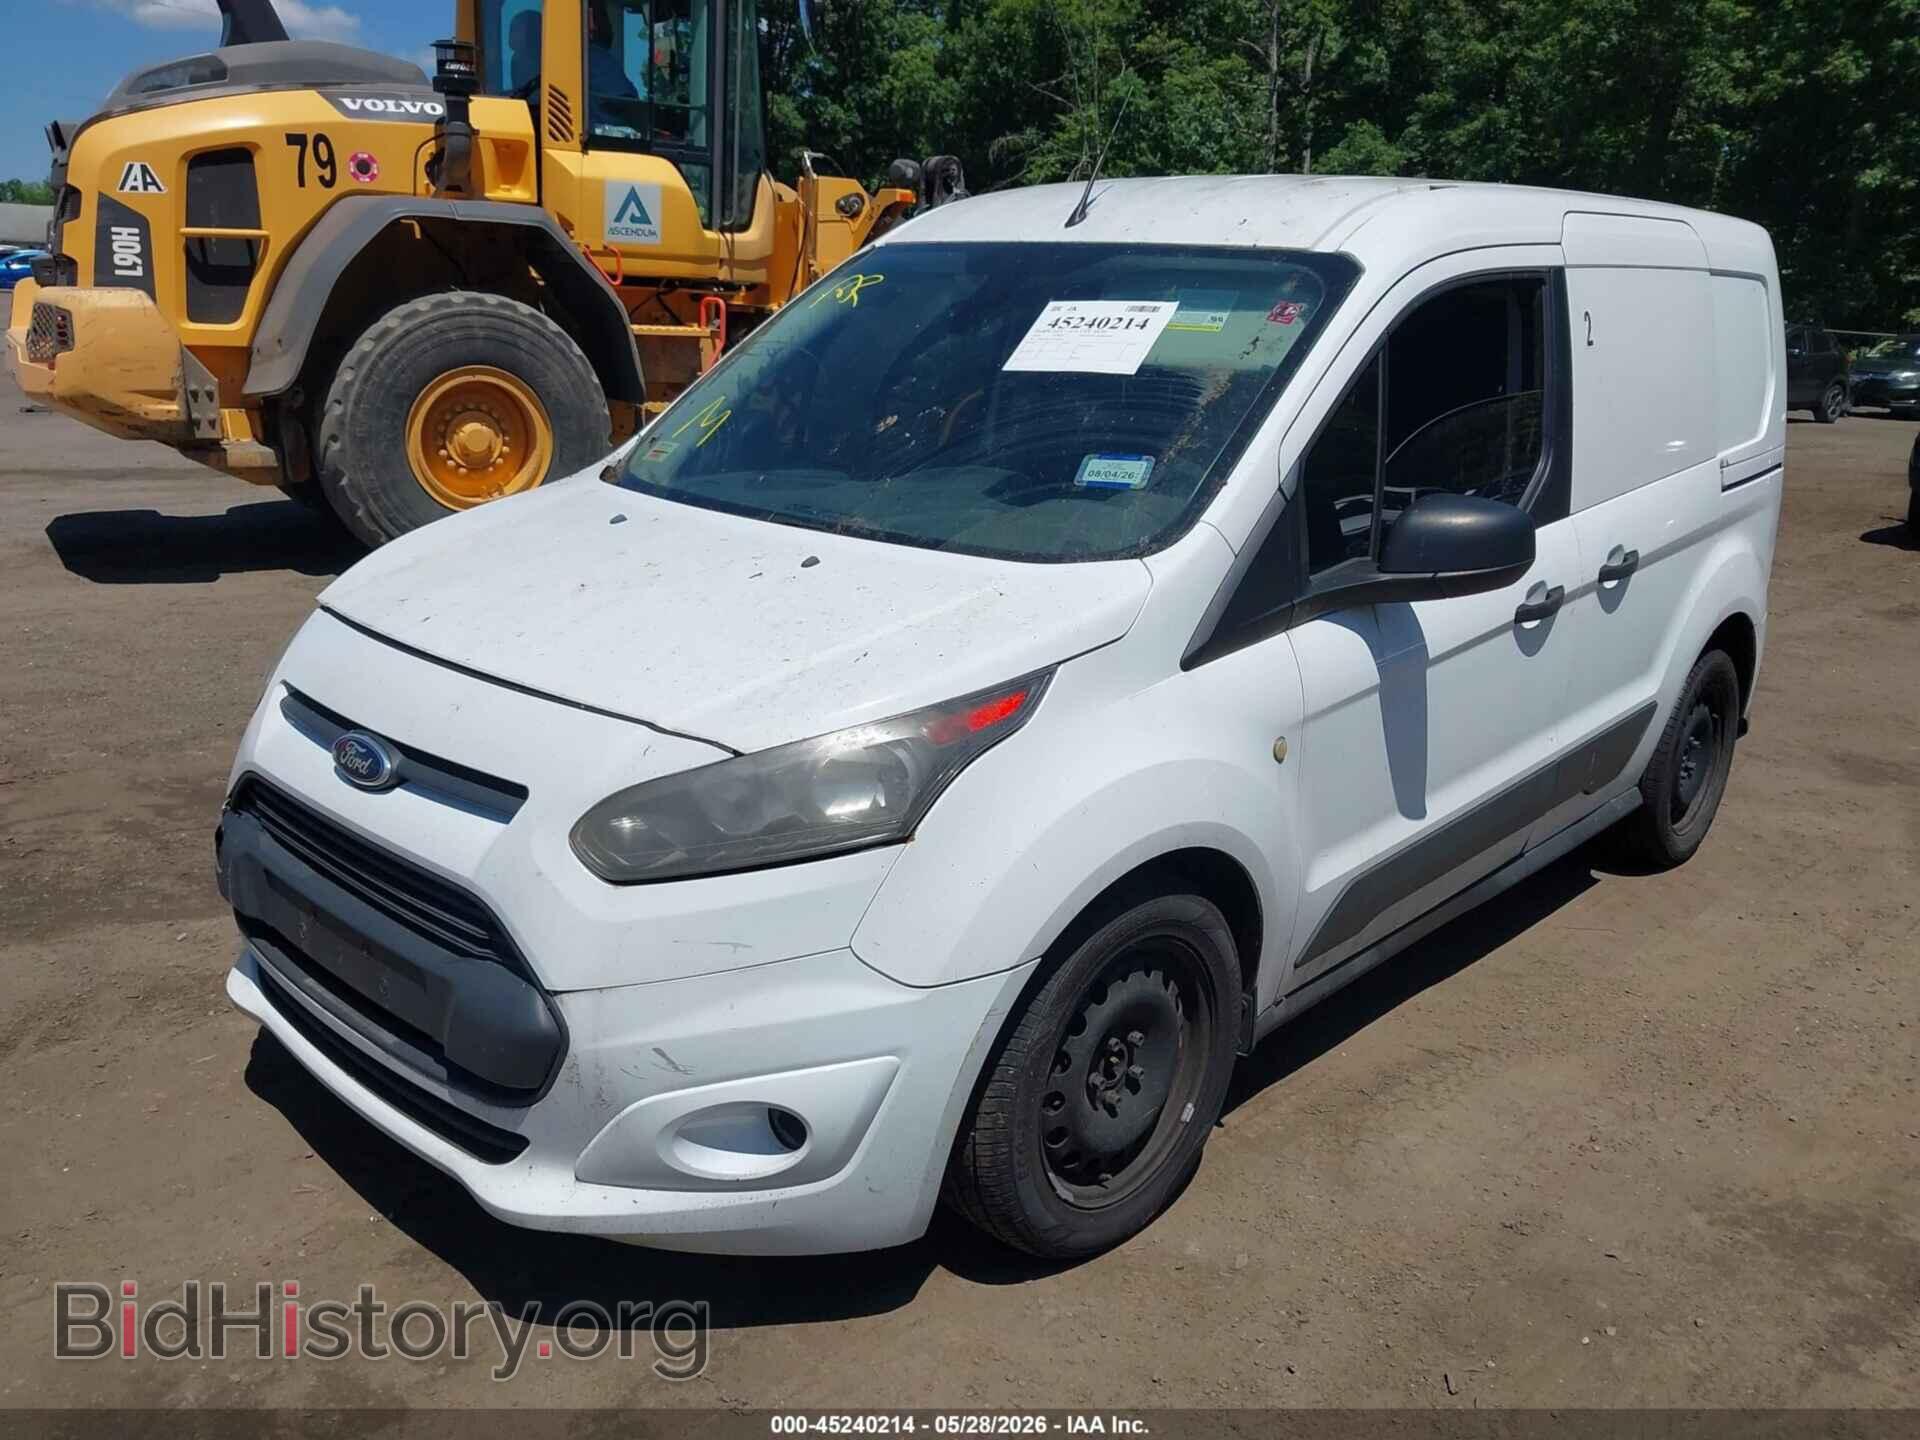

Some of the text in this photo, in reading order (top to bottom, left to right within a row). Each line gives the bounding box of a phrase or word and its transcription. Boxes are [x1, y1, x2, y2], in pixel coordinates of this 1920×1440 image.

[338, 97, 445, 116] VOLVO
[284, 132, 337, 189] 79
[607, 227, 658, 239] ASCENDUM
[110, 226, 144, 277] L90H
[1047, 316, 1150, 330] 45240214
[1583, 310, 1595, 347] 2
[341, 741, 373, 775] Ford
